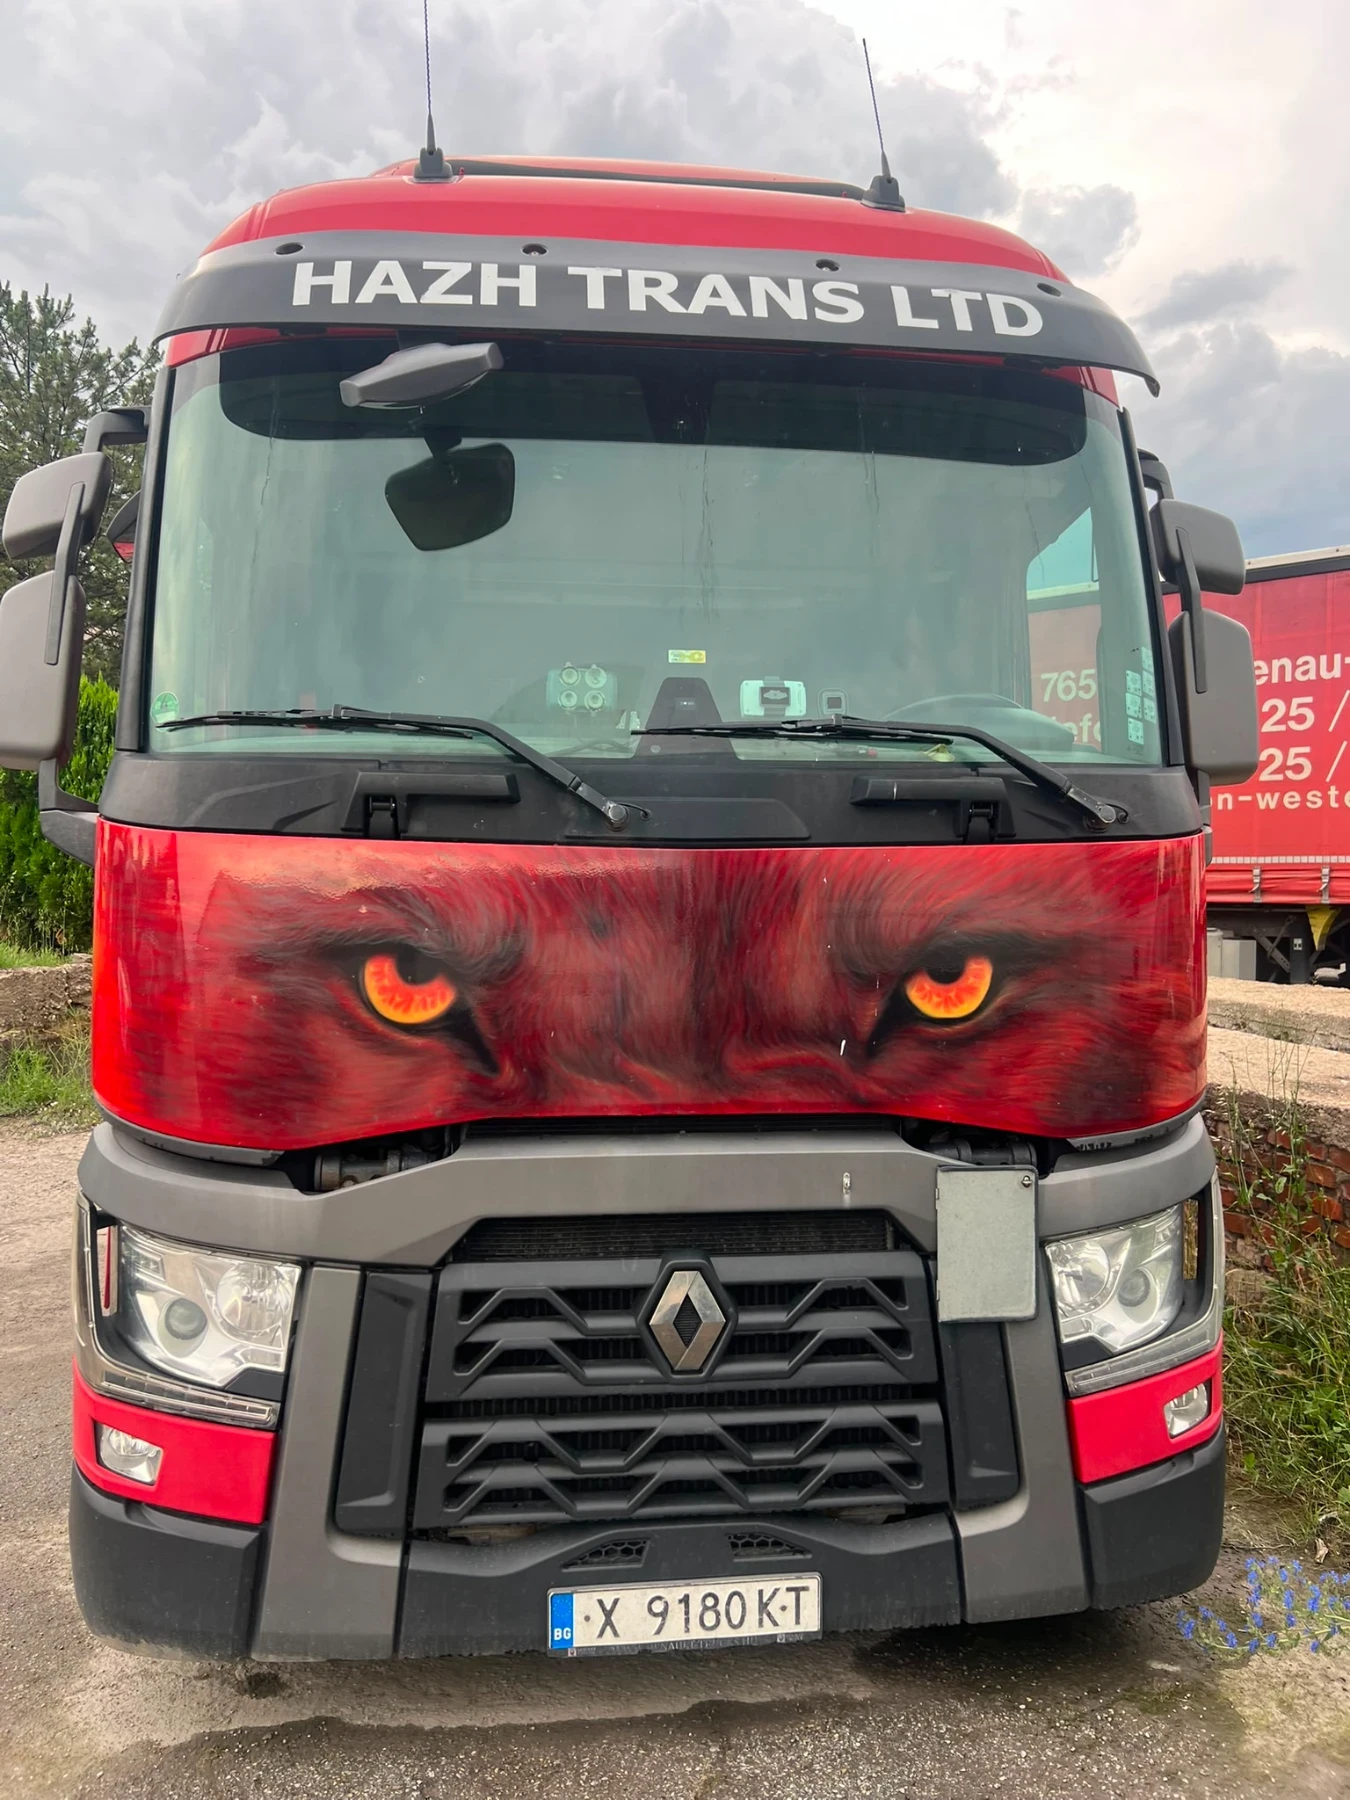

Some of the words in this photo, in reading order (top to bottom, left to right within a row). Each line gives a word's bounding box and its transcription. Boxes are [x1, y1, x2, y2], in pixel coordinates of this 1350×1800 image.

[292, 260, 537, 306] HAZH
[567, 266, 865, 324] TRANS
[891, 285, 1044, 337] LTD
[1261, 696, 1315, 733] 25
[1259, 746, 1312, 782] 25
[1210, 785, 1350, 811] n-west
[553, 1627, 571, 1641] BG
